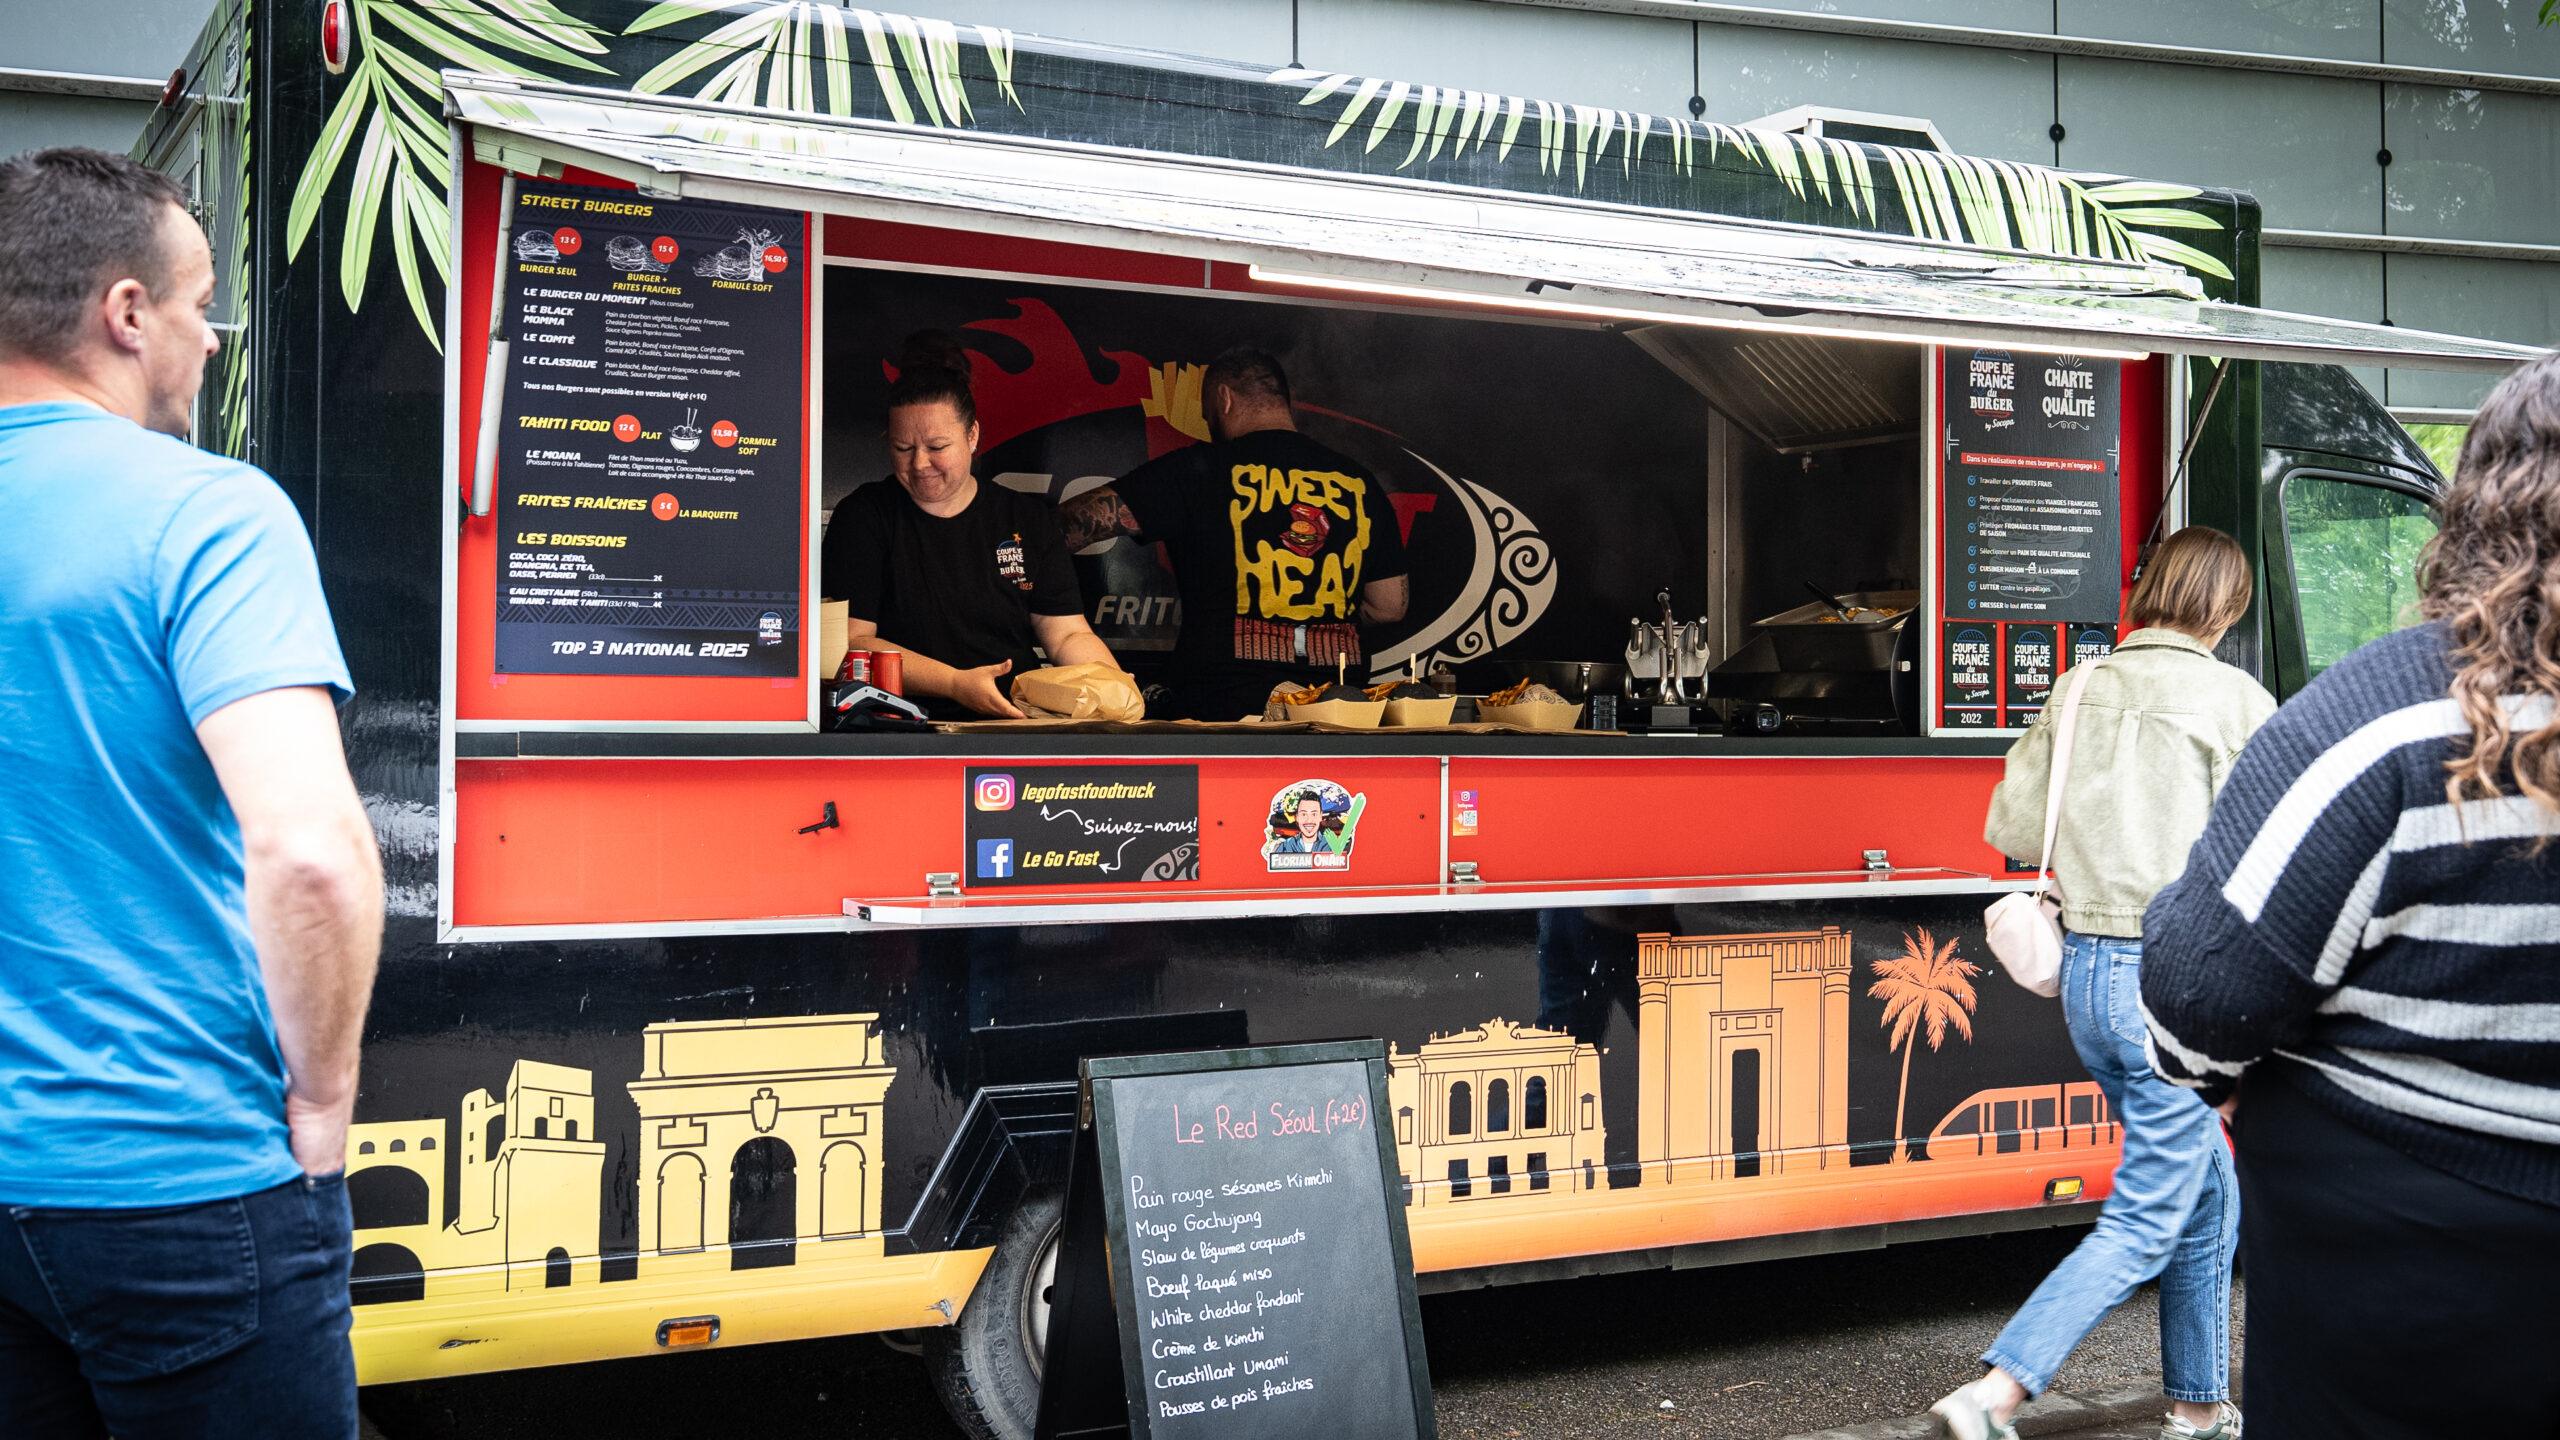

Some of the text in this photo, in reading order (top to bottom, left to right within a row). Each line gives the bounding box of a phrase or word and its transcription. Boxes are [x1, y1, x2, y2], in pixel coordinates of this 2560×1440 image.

[521, 195, 654, 217] STREET BURGERS
[560, 236, 569, 244] 13
[520, 264, 577, 276] BURGER SEUL
[627, 273, 660, 283] BURGER
[613, 282, 682, 295] FRITES FRAICHES
[712, 280, 773, 292] FORMULE SOFT
[523, 288, 538, 296] LE
[539, 289, 582, 300] BURGER
[584, 292, 600, 301] DU
[601, 293, 647, 305] MOMENT
[523, 305, 575, 316] LE BLACK
[523, 316, 565, 326] MOMMA
[522, 333, 576, 345] LE COMTÉ
[522, 356, 598, 369] LE CLASSIQUE
[1970, 360, 2015, 375] COUPE DE
[1970, 373, 2015, 390] FRANCE
[2044, 368, 2093, 390] CHARTE
[523, 382, 540, 390] Tous
[555, 384, 584, 393] Burgers
[584, 386, 601, 394] sont
[601, 387, 634, 396] possibles
[645, 390, 671, 398] version
[672, 391, 689, 400] Végé
[1987, 388, 1998, 398] du
[2063, 389, 2073, 399] DE
[1970, 396, 2014, 412] BURGER
[2042, 395, 2095, 418] QUALITÉ
[518, 416, 611, 432] TAHITI FOOD
[1985, 418, 2015, 432] by Socopa
[641, 431, 662, 440] PLAT
[738, 436, 777, 446] FORMULE
[526, 450, 581, 461] LE MOANA
[738, 447, 759, 456] SOFT
[1966, 455, 1981, 463] Dans
[2037, 460, 2060, 469] burgers,
[2011, 479, 2037, 487] PRODUITS
[2037, 480, 2053, 488] FRAIS
[517, 494, 648, 511] FRITES FRAÎCHES
[1230, 464, 1369, 536] SWEET
[691, 510, 739, 520] BARQUETTE
[517, 533, 627, 548] LES BOISSONS
[509, 553, 535, 561] COCA,
[536, 553, 560, 561] COCA
[575, 564, 595, 572] TEA,
[539, 571, 577, 579] PERRIER
[551, 641, 750, 658] TOP 3 NATIONAL 2025
[1952, 643, 1989, 654] COUPE DE
[2014, 644, 2050, 655] COUPE DE
[2075, 644, 2111, 654] COUPE DE
[1952, 653, 1989, 666] FRANCE
[2014, 655, 2050, 667] FRANCE
[1966, 665, 1975, 673] du
[2028, 666, 2037, 674] du
[1952, 672, 1989, 684] BURGER
[2014, 674, 2050, 685] BURGER
[1960, 713, 1982, 724] 2022
[1022, 782, 1156, 803] legofastfoodtruck
[1083, 817, 1198, 836] Suivez-nous!
[1022, 850, 1100, 868] Le Go Fast
[1271, 854, 1312, 868] FLORIAN
[1174, 1104, 1204, 1144] Le
[1215, 1105, 1258, 1140] Red
[1325, 1094, 1366, 1135] (+2€)
[1131, 1175, 1164, 1209] Pain
[1172, 1188, 1215, 1208] rouge
[1221, 1178, 1282, 1196] sésames
[1135, 1210, 1262, 1242] Mayo Gochujang
[1141, 1228, 1306, 1267] Slaw de légumes croquants
[1194, 1269, 1238, 1294] laqué
[1242, 1267, 1273, 1283] miso
[1151, 1287, 1305, 1329] White cheddar fondant
[1152, 1338, 1197, 1360] Crème
[1203, 1335, 1221, 1352] de
[1154, 1351, 1289, 1389] Croustillant Umami
[1159, 1377, 1314, 1418] Pousses de pois fraîches
